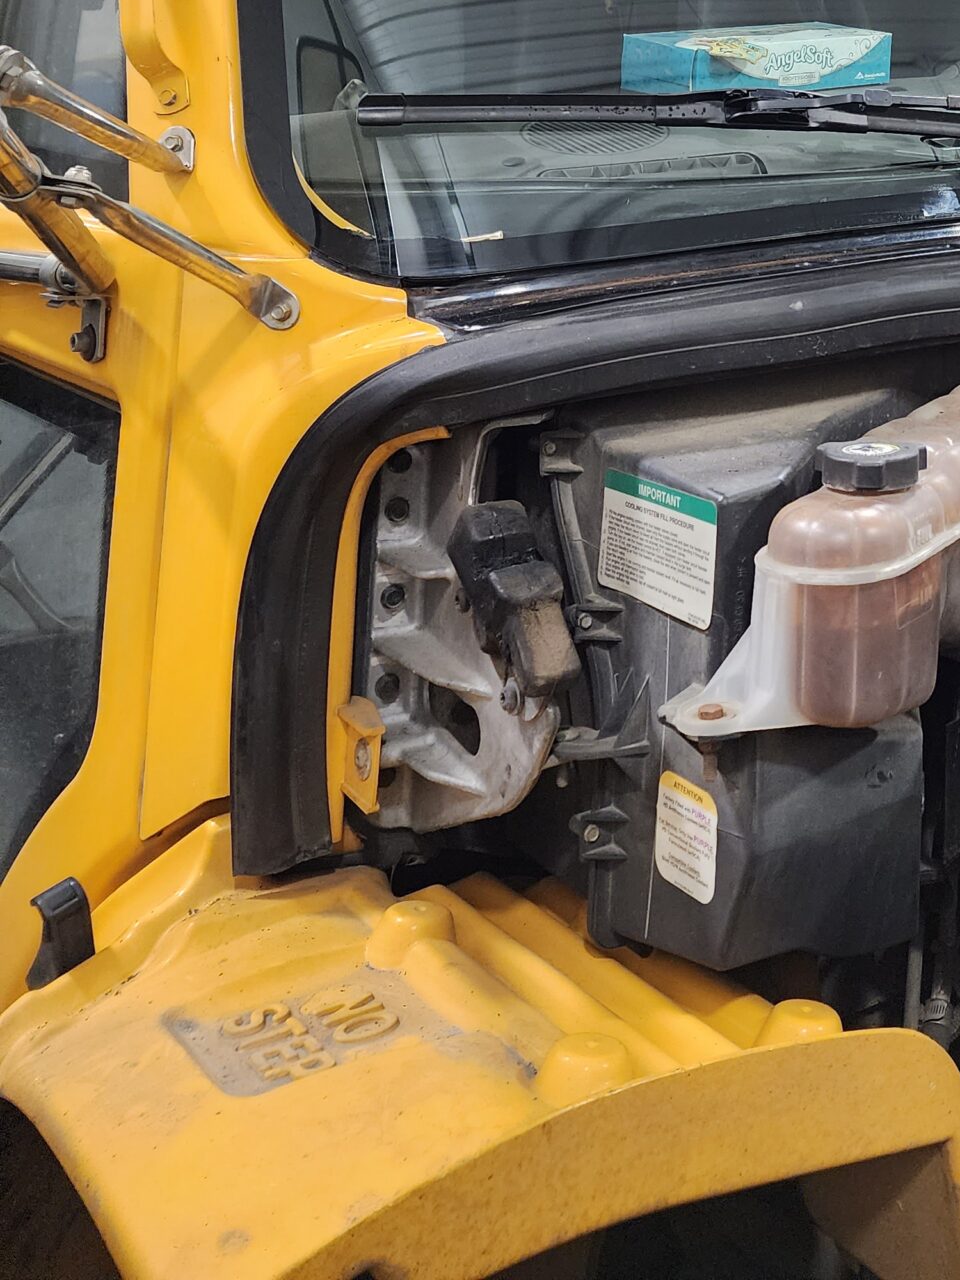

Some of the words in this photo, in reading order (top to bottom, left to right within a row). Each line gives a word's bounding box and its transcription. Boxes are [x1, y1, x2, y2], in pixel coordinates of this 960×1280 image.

[638, 483, 682, 508] IMPORTANT
[624, 500, 643, 513] COOLING
[643, 506, 660, 518] SYSTEM
[660, 511, 669, 521] FILL
[673, 780, 703, 804] ATTENTION
[299, 984, 401, 1044] NO
[222, 1002, 337, 1082] STEP
